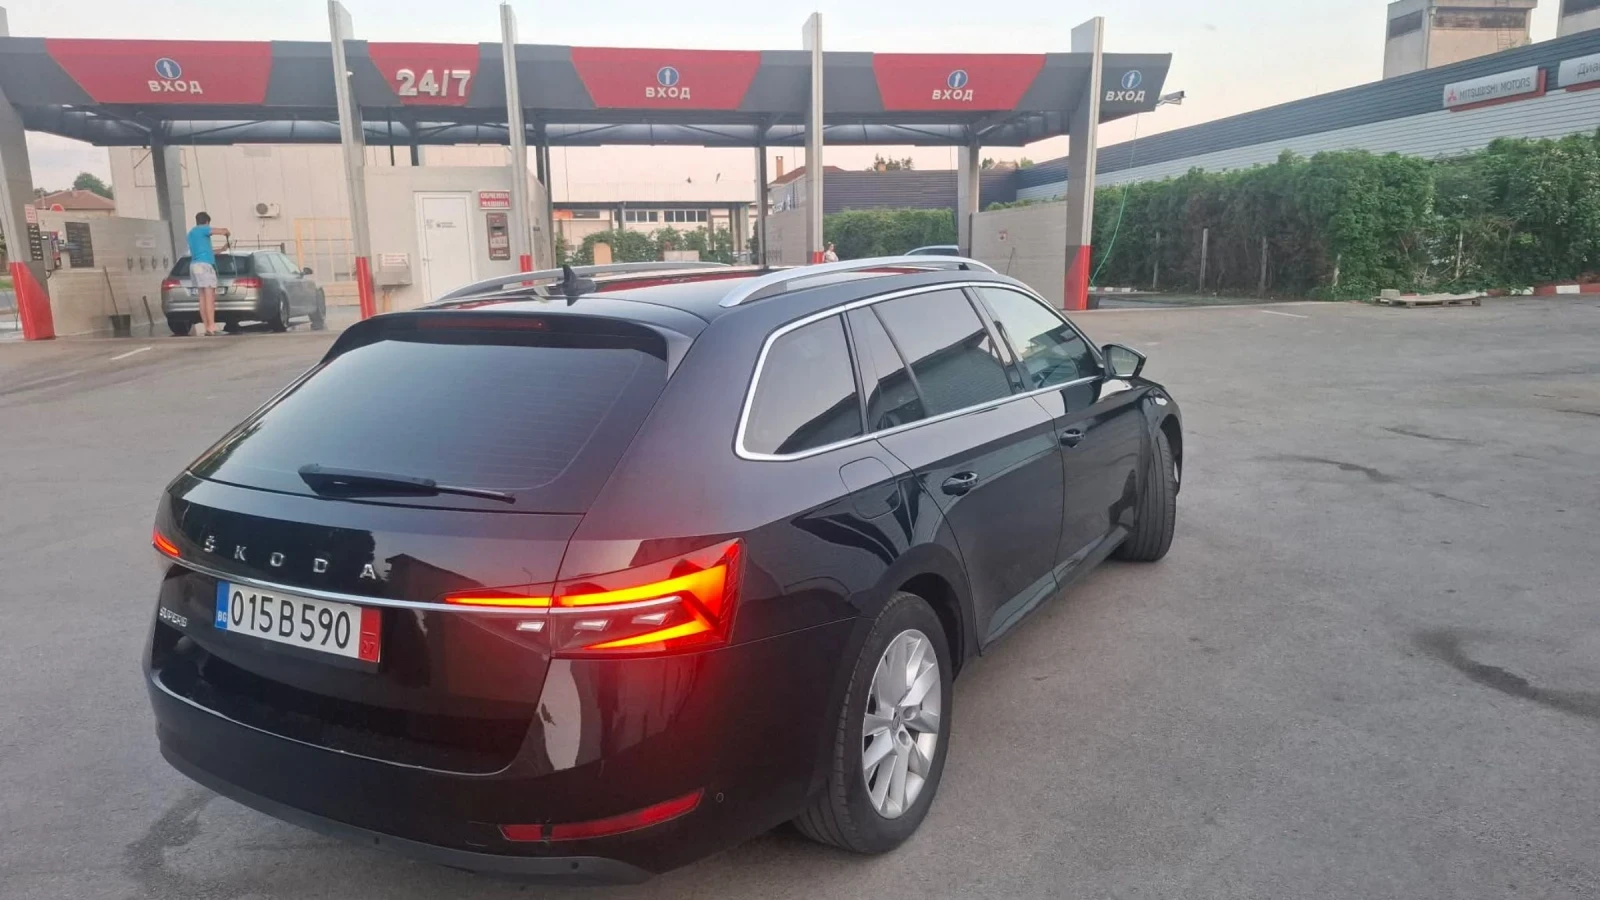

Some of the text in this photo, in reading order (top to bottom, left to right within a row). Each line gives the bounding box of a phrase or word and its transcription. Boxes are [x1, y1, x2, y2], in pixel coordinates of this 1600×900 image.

[1576, 62, 1600, 79] Диа
[148, 80, 203, 94] ВХОД
[396, 68, 471, 96] 24/7
[1459, 77, 1531, 101] MITSUBISHI MOTORS
[645, 87, 691, 100] ВХОД
[932, 89, 974, 102] ВХОД
[1105, 90, 1146, 103] ВХОД
[203, 535, 376, 580] ŠKODA
[159, 606, 188, 627] SUPERB
[217, 611, 227, 622] BG
